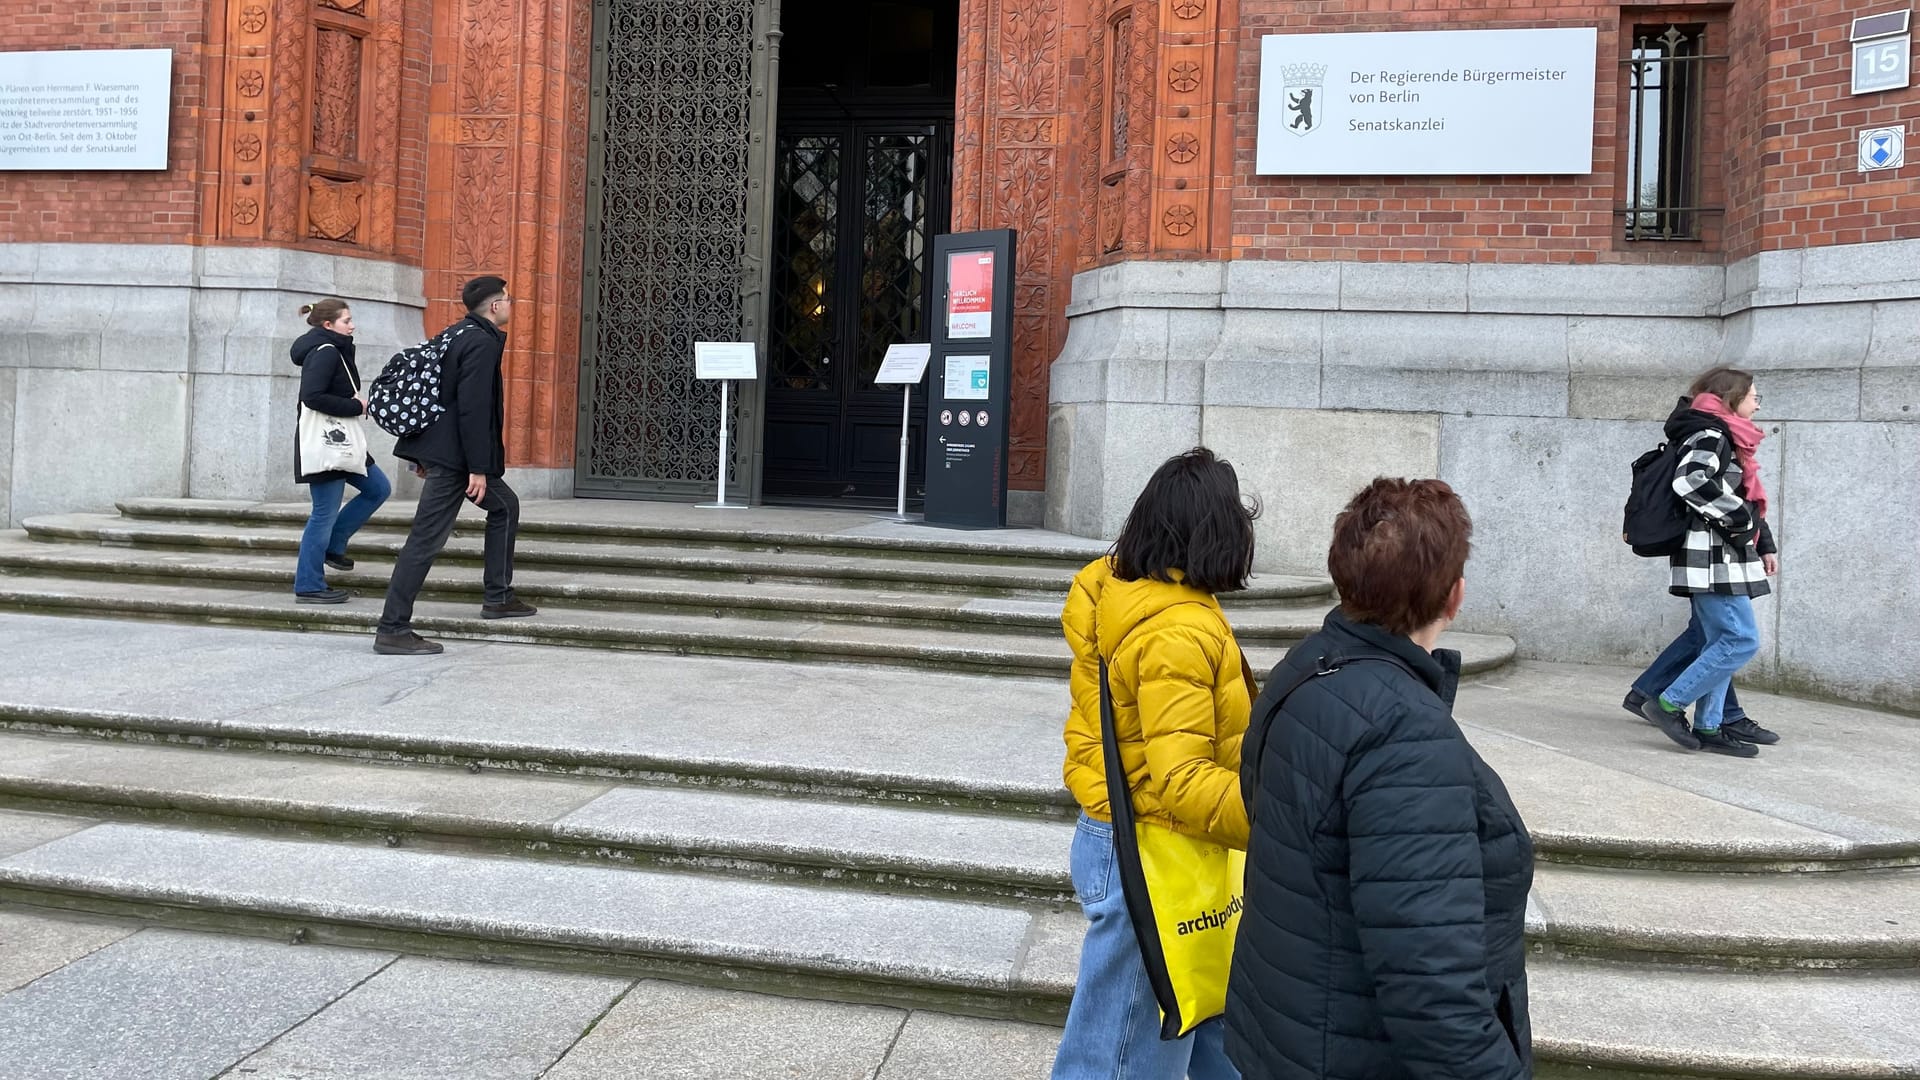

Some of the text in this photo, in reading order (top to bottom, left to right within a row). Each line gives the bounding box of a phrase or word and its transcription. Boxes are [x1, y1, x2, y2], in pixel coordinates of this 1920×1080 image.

[1863, 44, 1900, 74] 15
[1351, 67, 1567, 87] Der Regierende Bürgermeister
[105, 95, 120, 104] und
[124, 94, 138, 104] des
[1349, 90, 1420, 103] von Berlin
[11, 120, 22, 129] der
[1349, 117, 1445, 132] Senatskanzlei
[59, 131, 74, 141] Seit
[76, 131, 93, 141] dem
[105, 131, 137, 141] Oktober
[53, 144, 68, 153] und
[71, 144, 83, 153] der
[86, 143, 137, 153] Senatskanzlei
